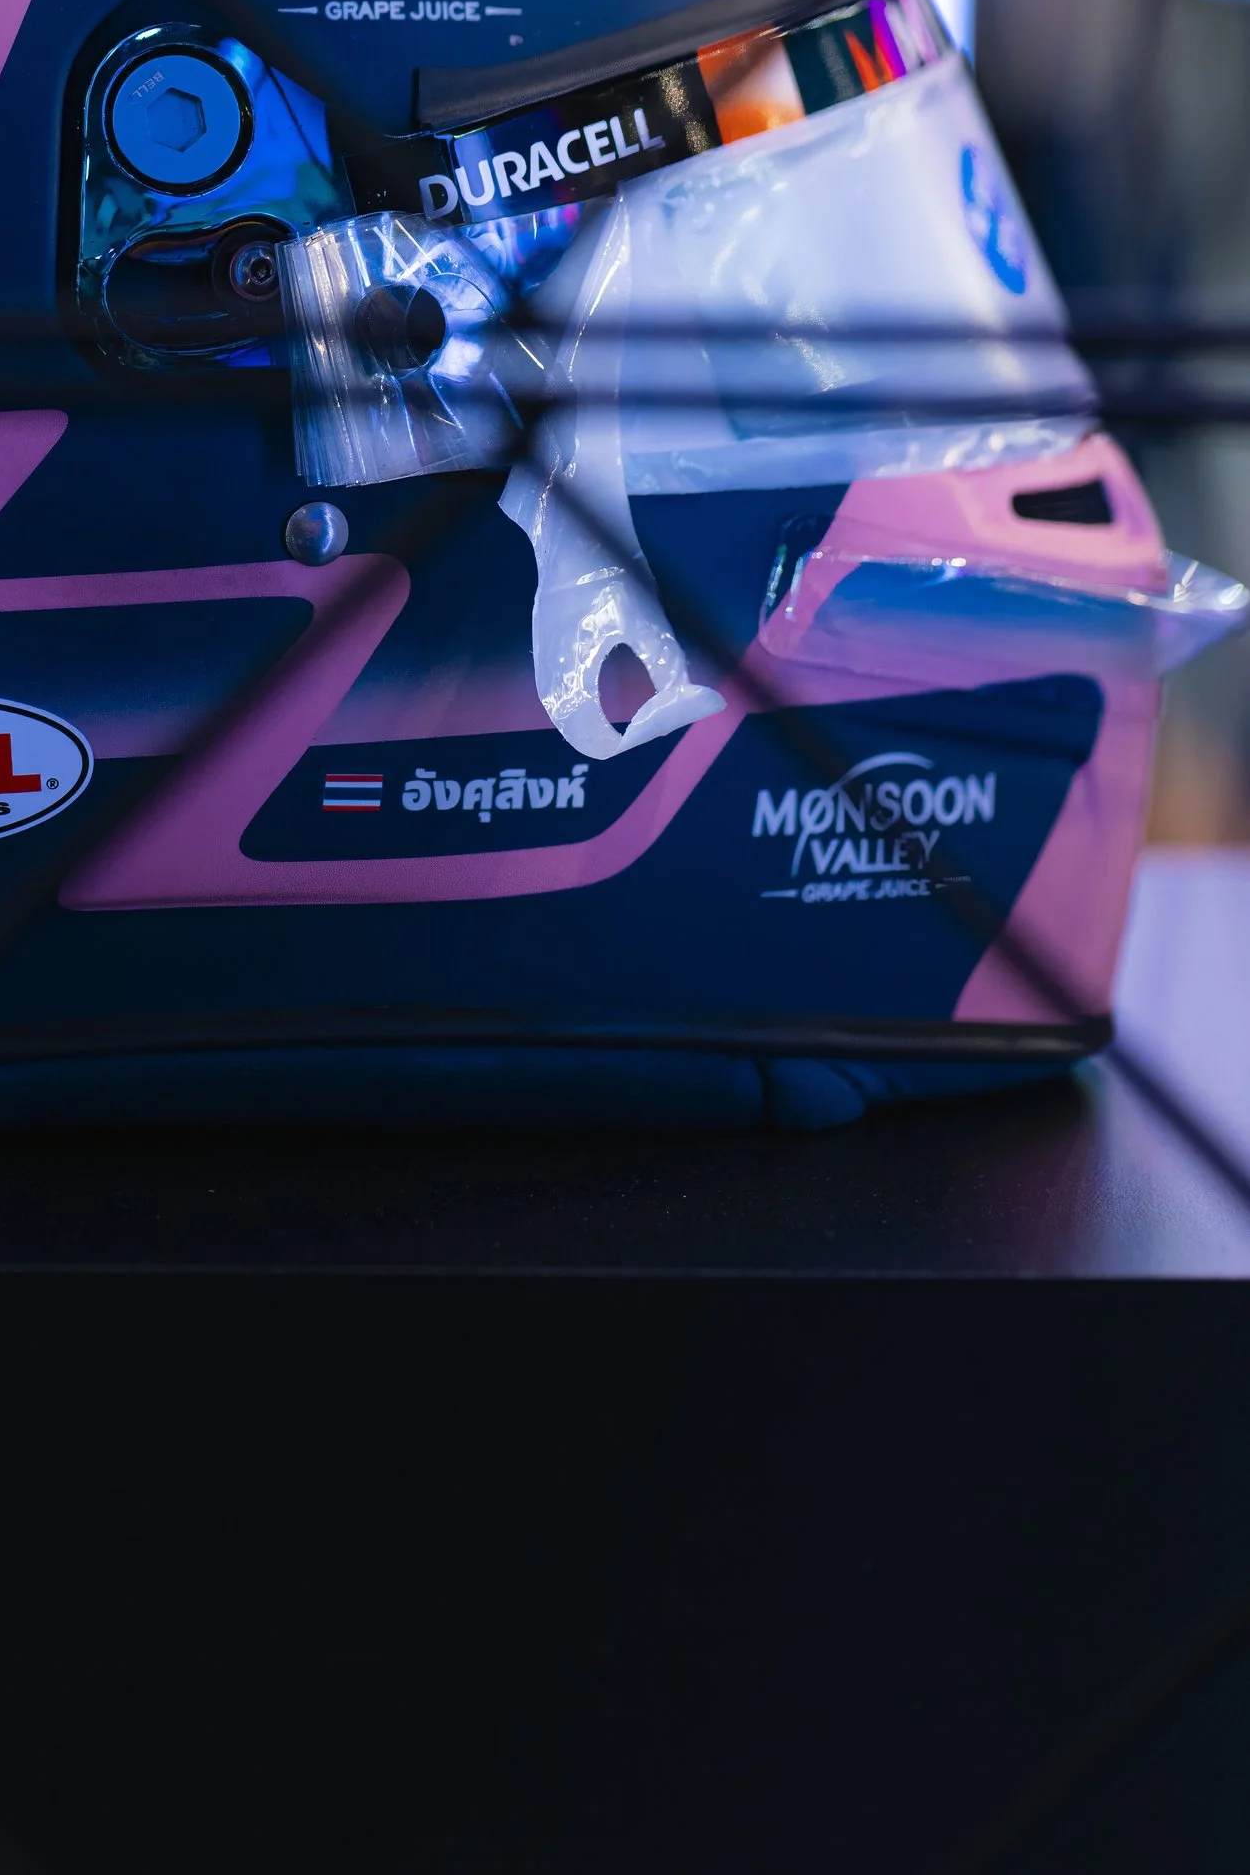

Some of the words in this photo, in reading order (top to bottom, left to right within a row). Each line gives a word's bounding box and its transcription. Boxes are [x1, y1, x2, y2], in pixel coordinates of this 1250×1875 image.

[324, 0, 406, 21] GRAPE
[409, 0, 481, 22] JUICE
[418, 107, 666, 222] DURACELL
[809, 829, 940, 876] VALLEY
